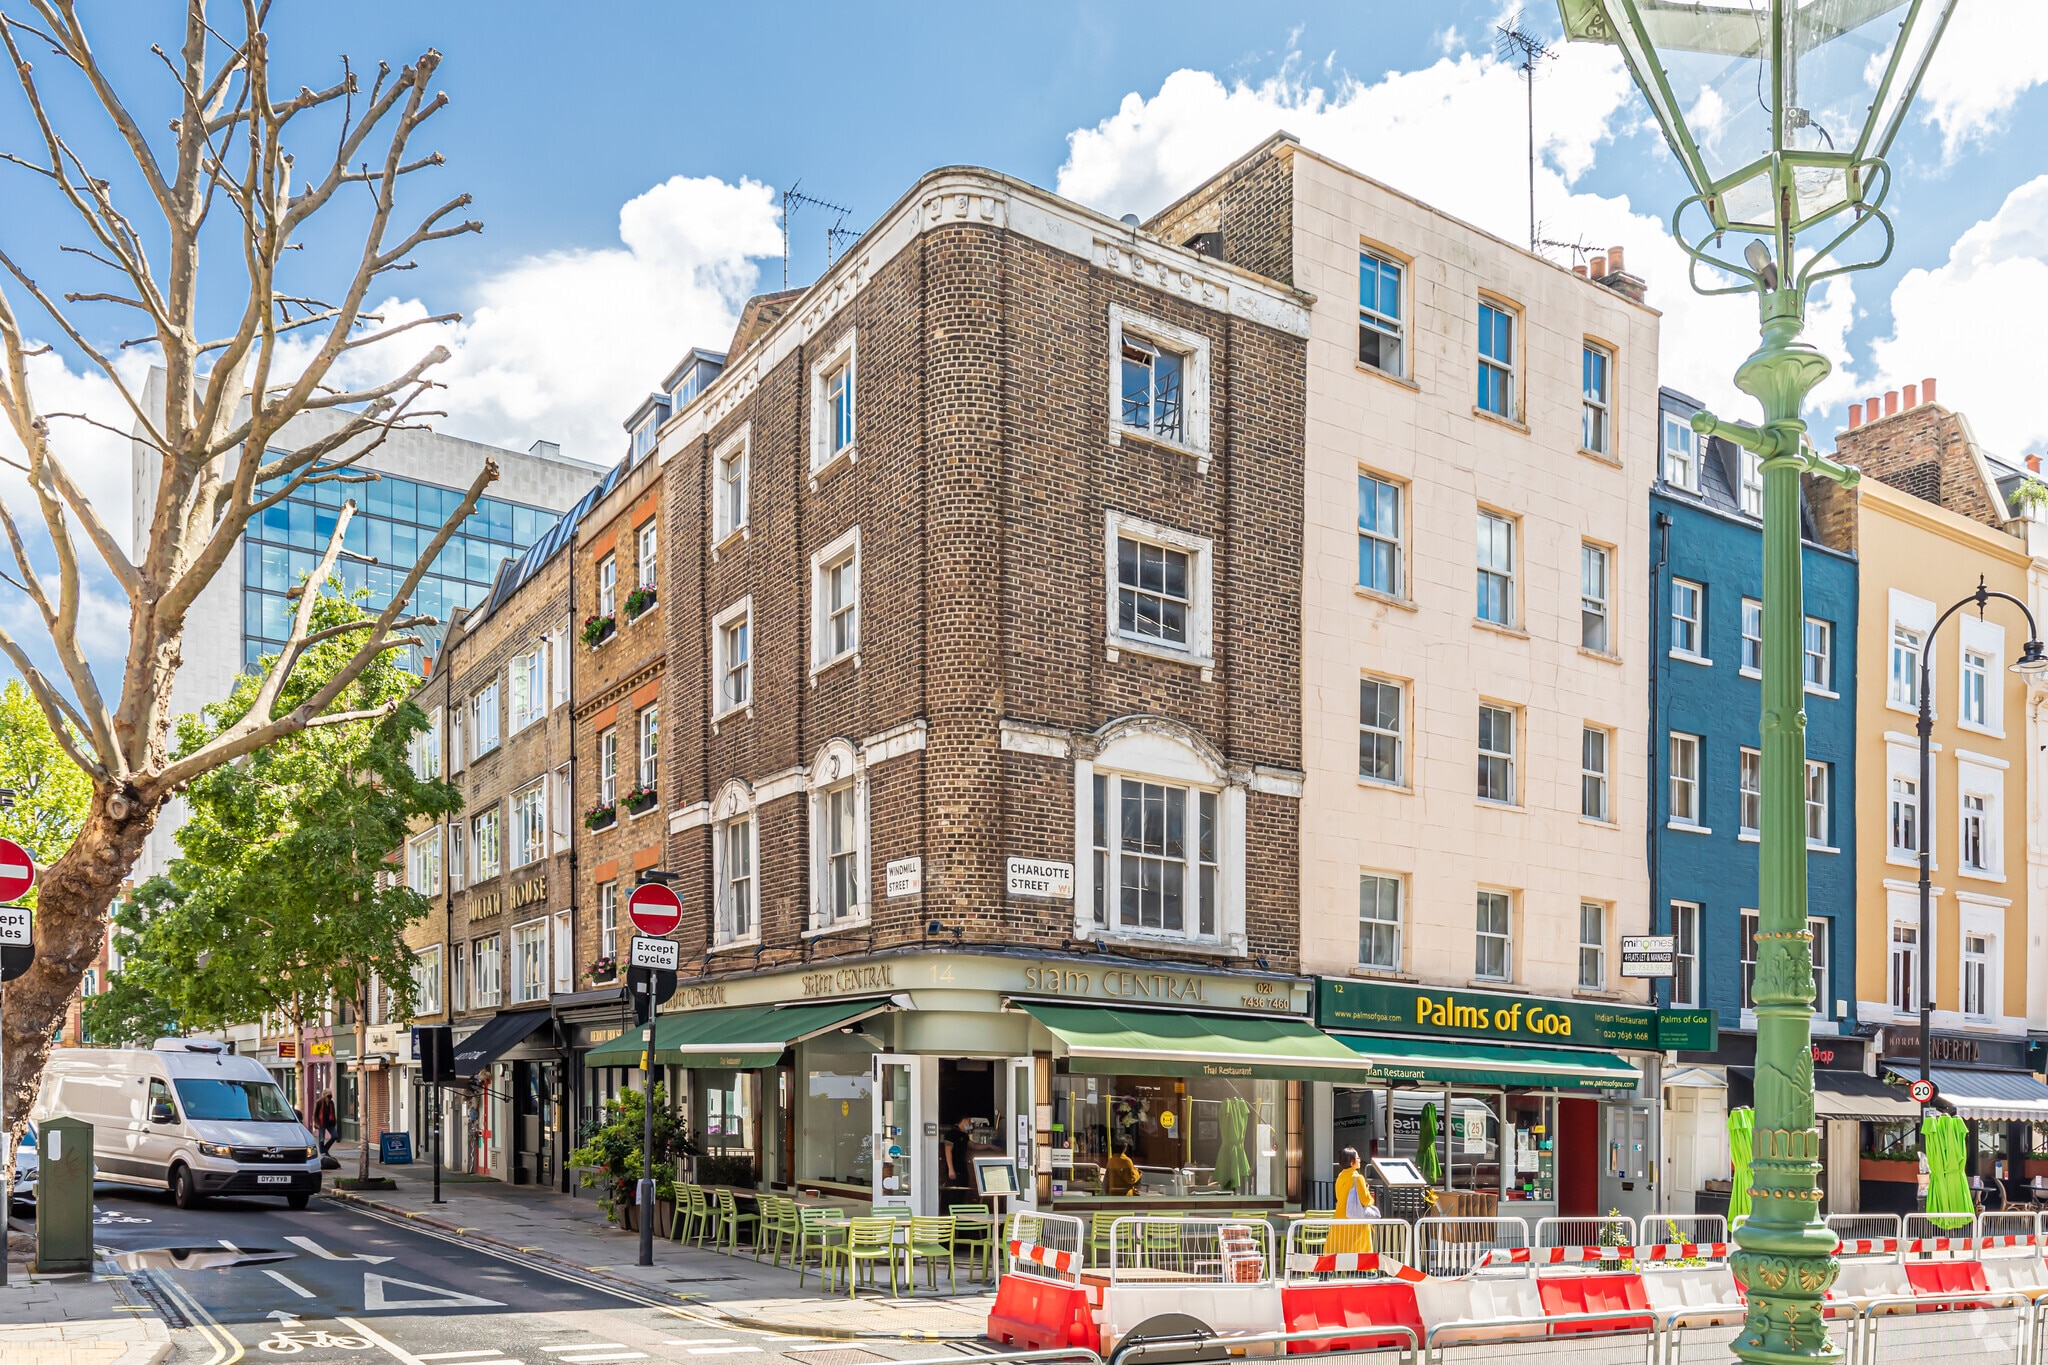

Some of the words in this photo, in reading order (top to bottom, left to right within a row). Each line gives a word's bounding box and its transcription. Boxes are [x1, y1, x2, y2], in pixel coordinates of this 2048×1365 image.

[888, 863, 917, 877] WINDMILL
[1010, 864, 1070, 879] CHARLOTTE
[888, 879, 909, 892] STREET
[1011, 879, 1050, 892] STREET
[509, 875, 546, 909] HOUSE
[0, 915, 25, 926] ept
[0, 927, 22, 938] les
[637, 942, 675, 954] Except
[638, 955, 672, 965] cycles
[836, 964, 895, 992] CENTRAL
[929, 964, 956, 983] 14
[1103, 970, 1208, 1002] CENTRAL
[1257, 983, 1275, 994] 020
[1334, 984, 1344, 994] 12
[1242, 996, 1265, 1008] 7436
[1267, 998, 1289, 1009] 7460
[1334, 1010, 1402, 1022] www.palmsofgoa.com
[1416, 996, 1490, 1029] Palms
[1494, 1003, 1522, 1032] of
[1525, 1007, 1571, 1036] Goa
[1595, 1014, 1615, 1023] Indian
[1615, 1014, 1649, 1025] Restaurant
[1660, 1015, 1682, 1024] Palms
[1683, 1015, 1691, 1024] of
[1692, 1015, 1708, 1024] Goa
[1603, 1030, 1616, 1039] 020
[1617, 1030, 1633, 1041] 7636
[1633, 1032, 1649, 1041] 1668
[1889, 1036, 1920, 1046] NORMA
[1932, 1039, 1980, 1062] NORMA
[1203, 1065, 1218, 1075] Thai
[1218, 1066, 1252, 1076] Restaurant
[1383, 1068, 1425, 1079] Restaurant
[1914, 1086, 1930, 1096] 20
[1471, 1122, 1480, 1134] 25
